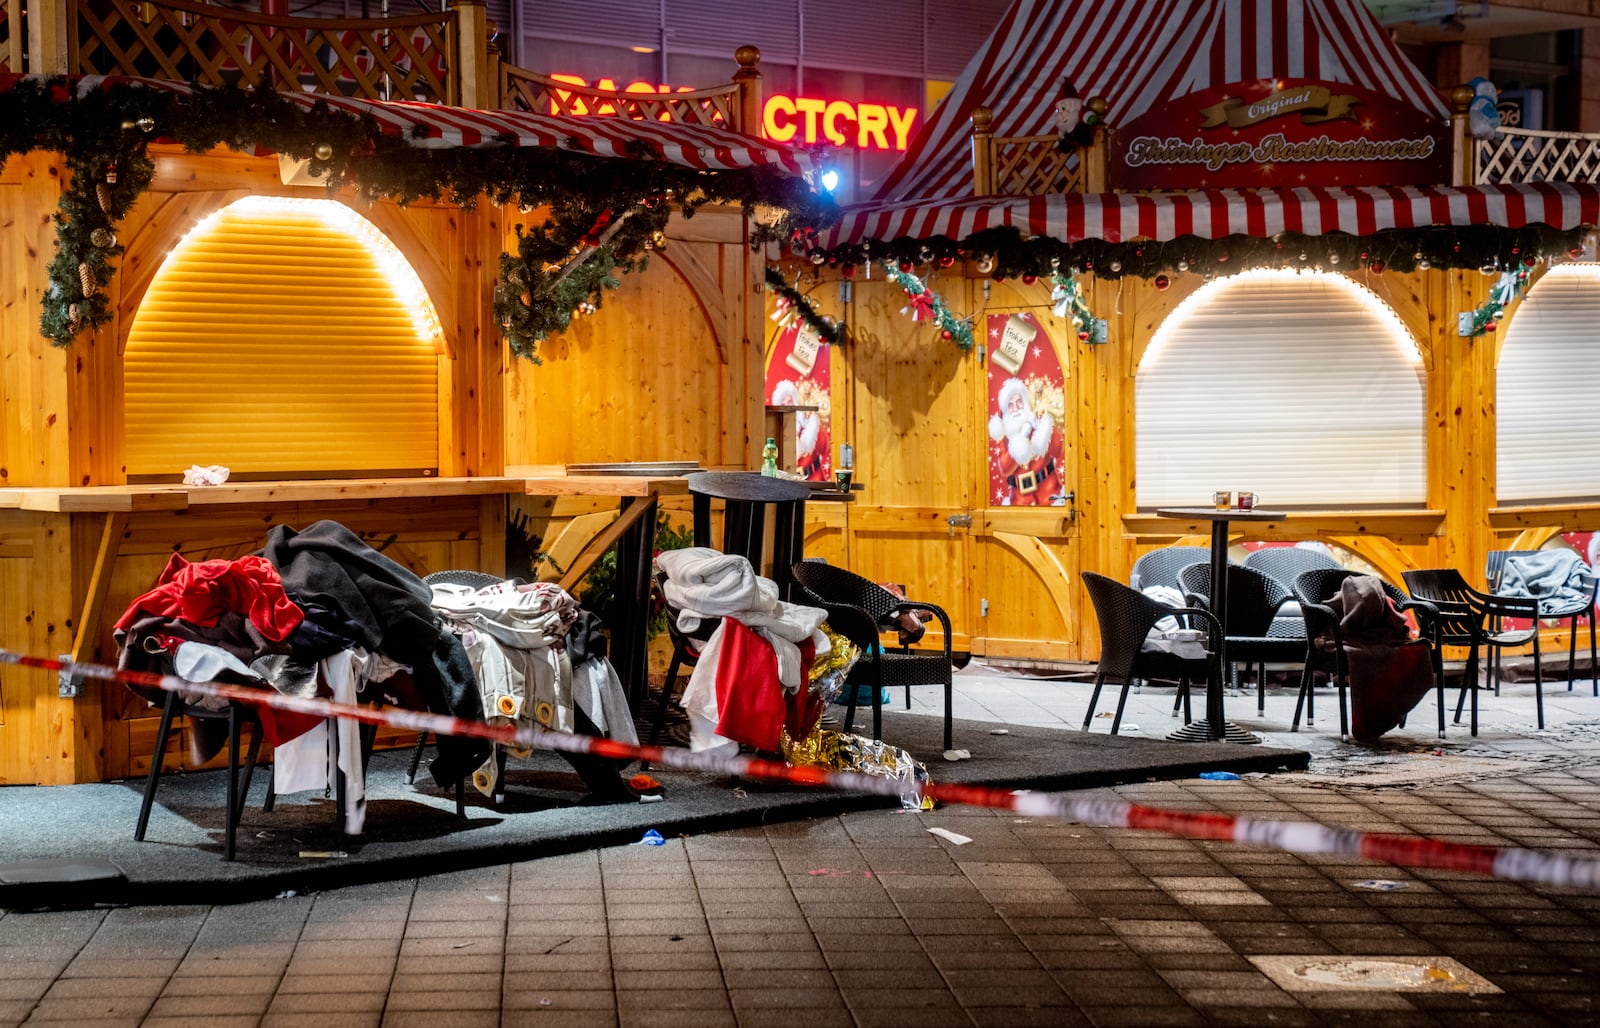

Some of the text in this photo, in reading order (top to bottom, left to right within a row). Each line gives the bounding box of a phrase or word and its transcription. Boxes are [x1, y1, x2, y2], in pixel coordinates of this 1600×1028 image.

[704, 92, 919, 150] CTORY
[1247, 90, 1311, 119] Original
[1125, 131, 1437, 172] Thüringer Rostbratwurst
